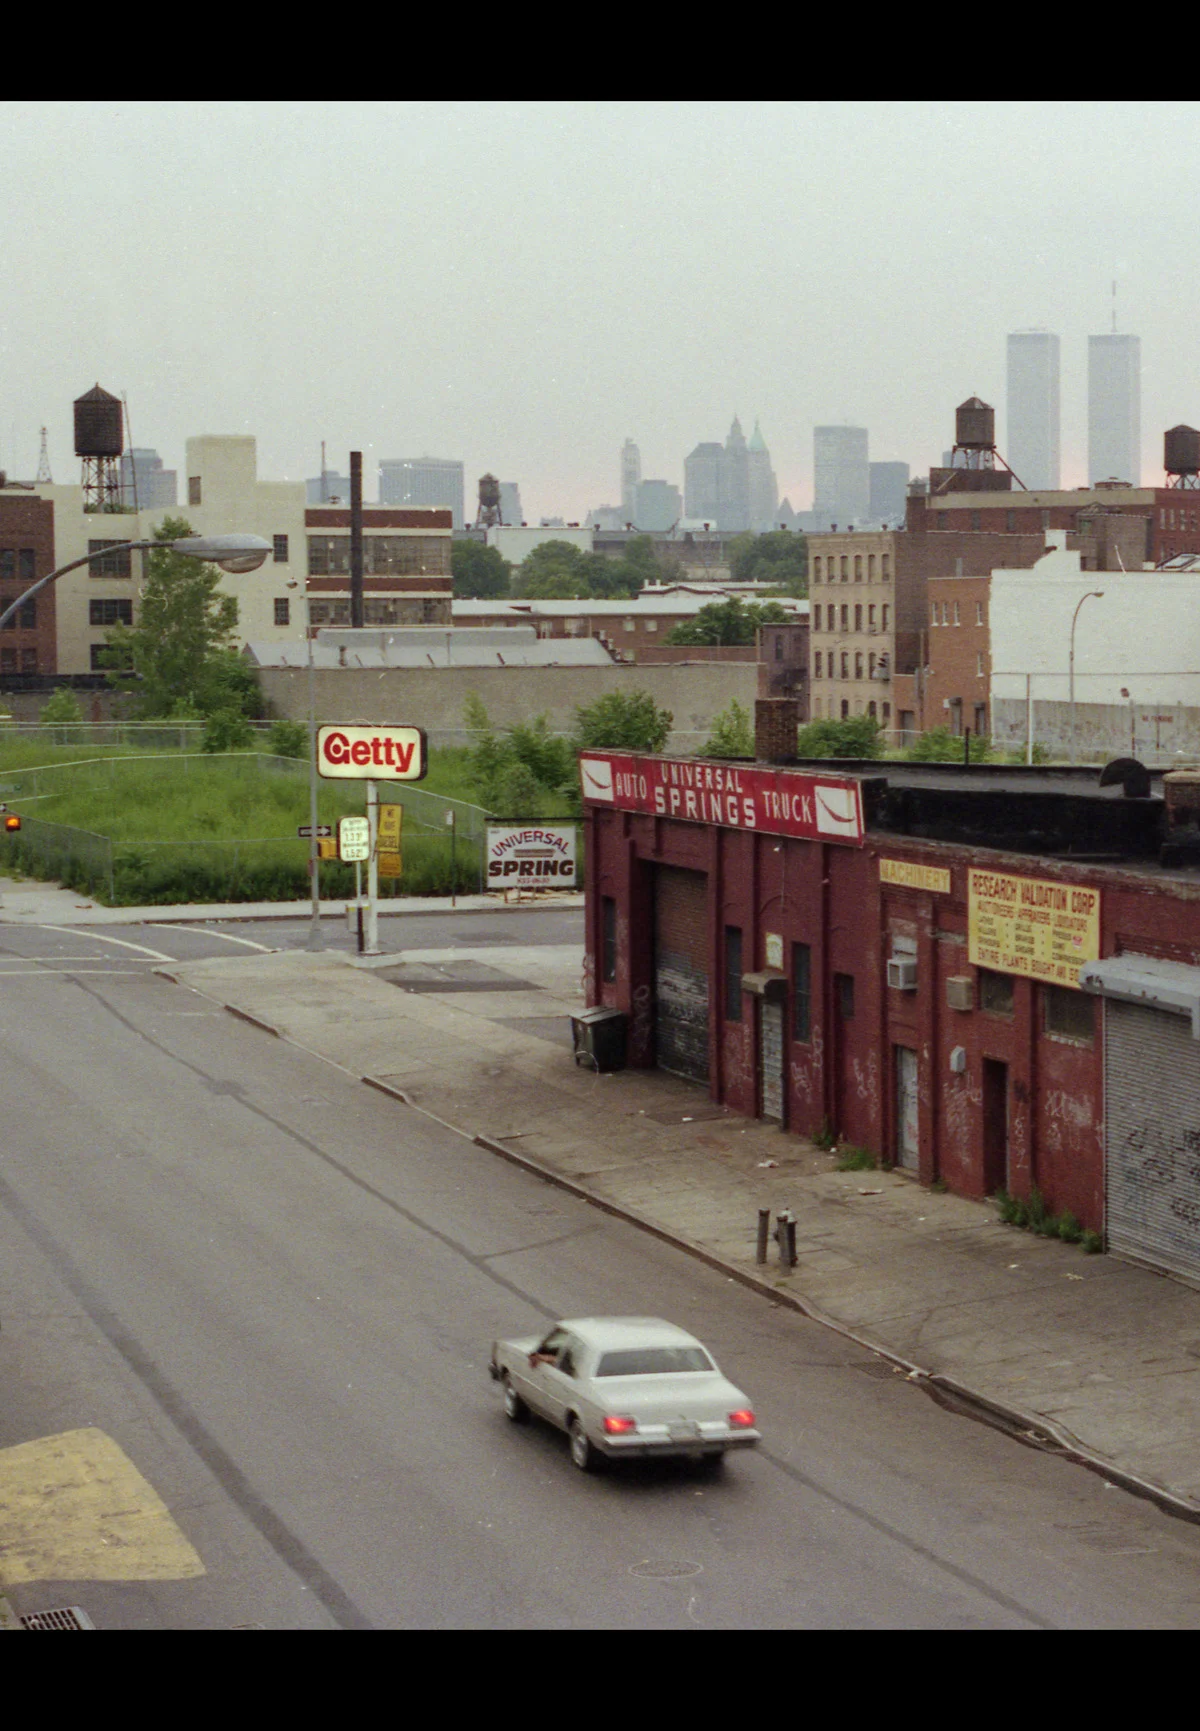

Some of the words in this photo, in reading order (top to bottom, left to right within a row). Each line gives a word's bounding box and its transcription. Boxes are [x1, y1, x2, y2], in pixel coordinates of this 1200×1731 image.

[323, 732, 415, 773] Getty
[661, 762, 744, 794] UNIVERSAL
[615, 772, 647, 800] AUTO
[655, 785, 757, 828] SPRINGS
[762, 790, 813, 824] TRUCK
[491, 830, 570, 857] UNIVERSAL
[488, 859, 574, 877] SPRING
[972, 873, 1017, 902] RESEARCH
